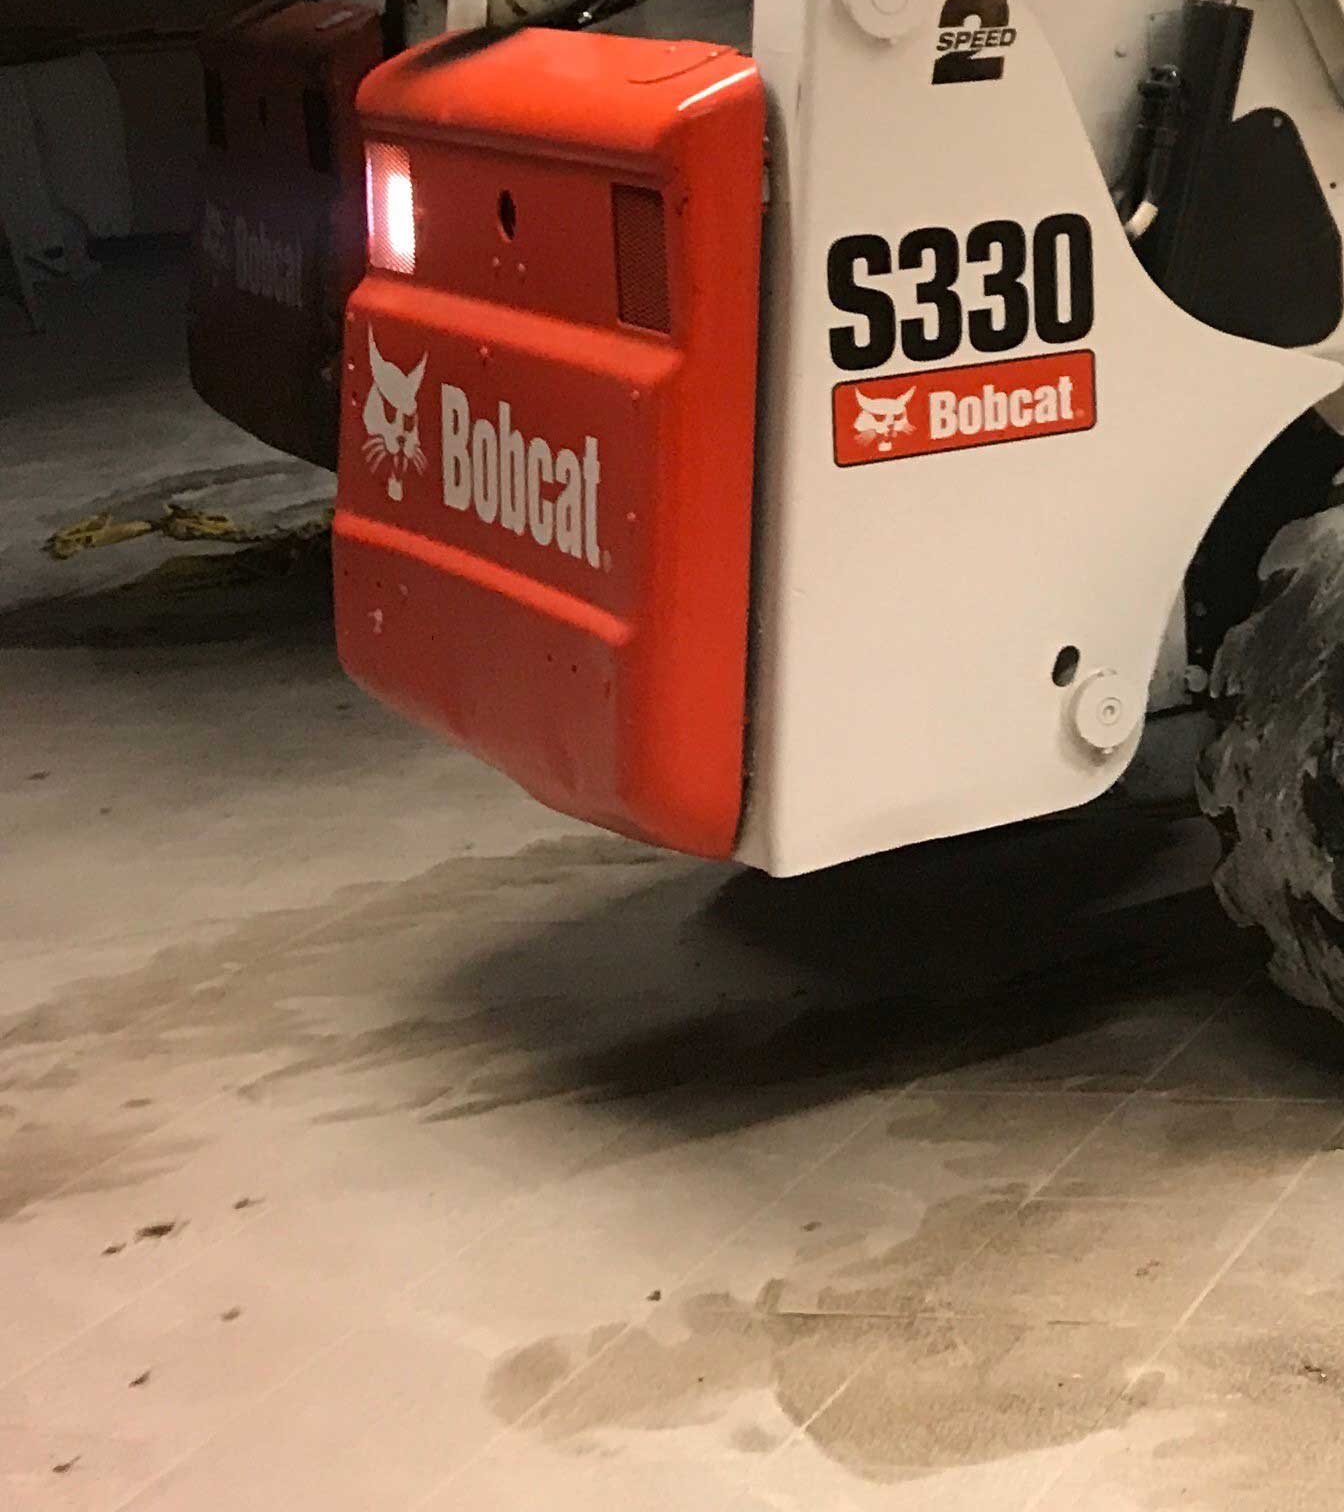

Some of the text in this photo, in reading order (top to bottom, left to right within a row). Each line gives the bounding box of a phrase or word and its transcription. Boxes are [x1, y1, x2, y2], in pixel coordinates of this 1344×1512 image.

[936, 28, 1017, 51] SPEED
[827, 213, 1094, 371] S330
[928, 376, 1075, 439] Bobcat
[441, 382, 600, 569] Bobcat
